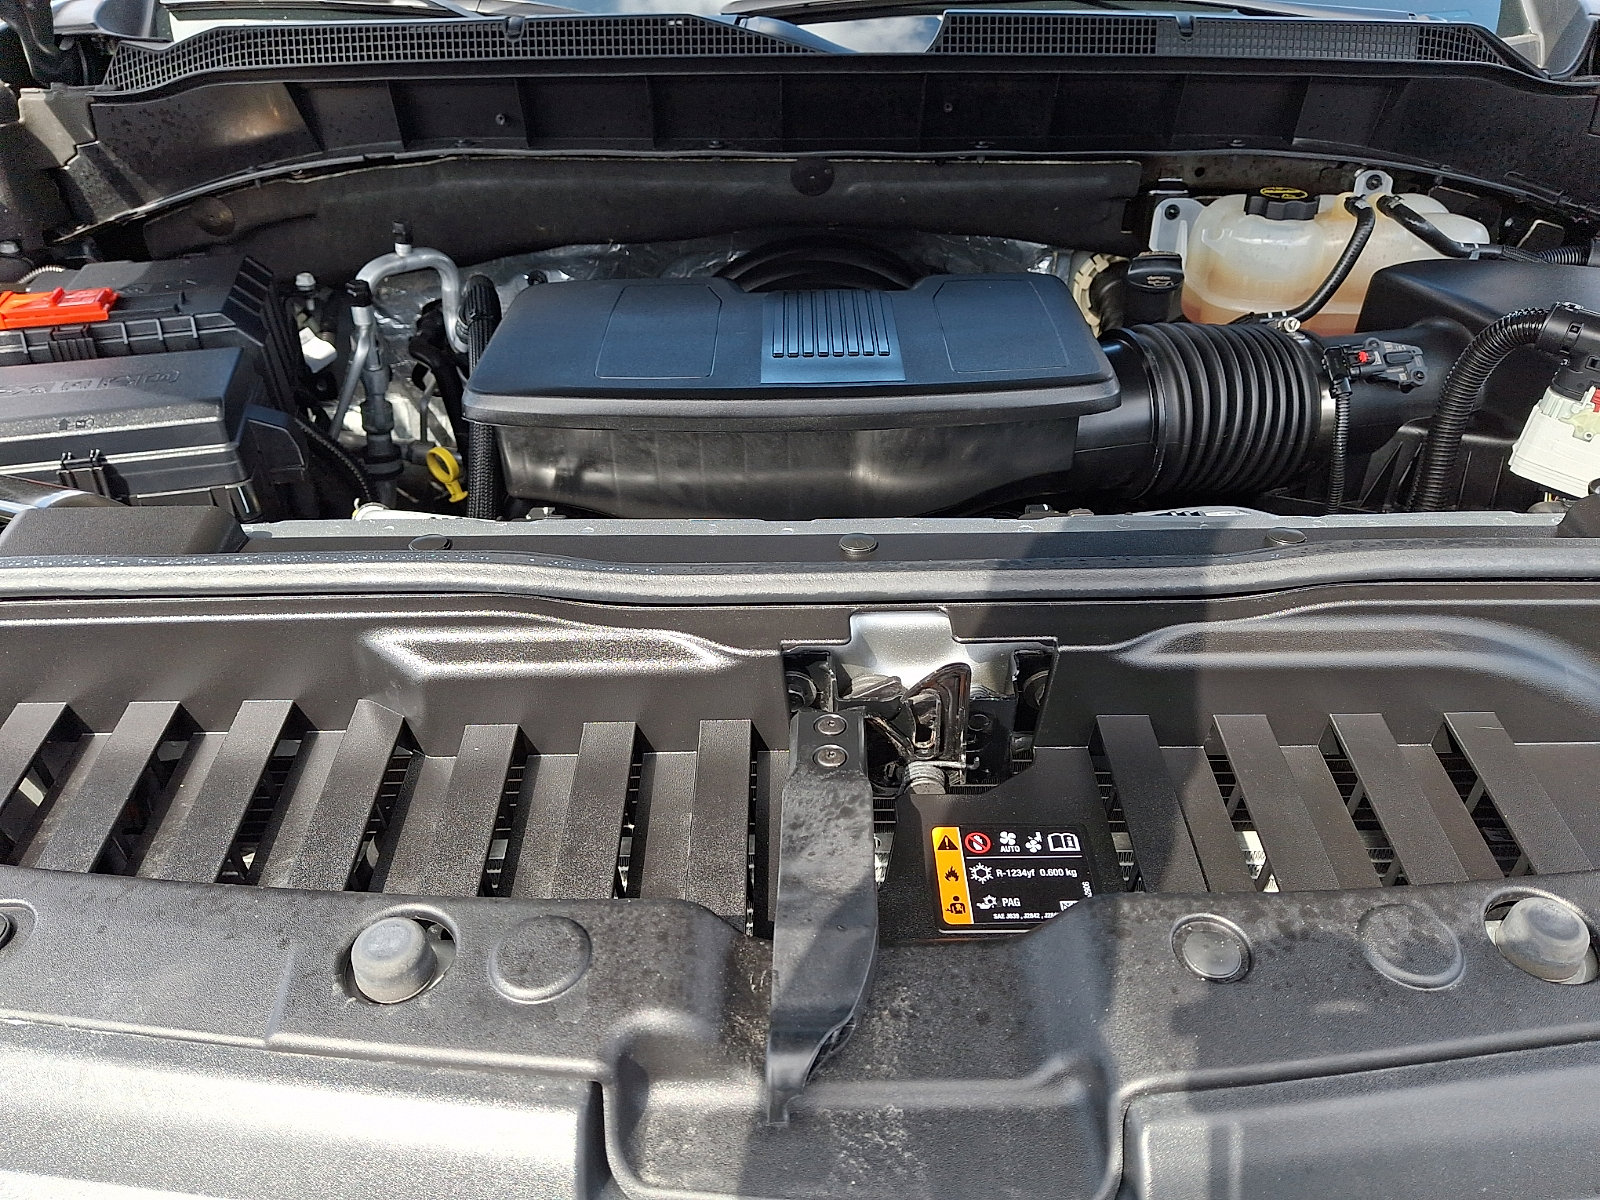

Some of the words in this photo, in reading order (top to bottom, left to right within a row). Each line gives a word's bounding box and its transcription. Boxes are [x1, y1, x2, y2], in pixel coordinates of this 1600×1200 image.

[996, 869, 1035, 878] R-1234yf
[1065, 868, 1077, 877] kg
[1001, 898, 1021, 906] PAG
